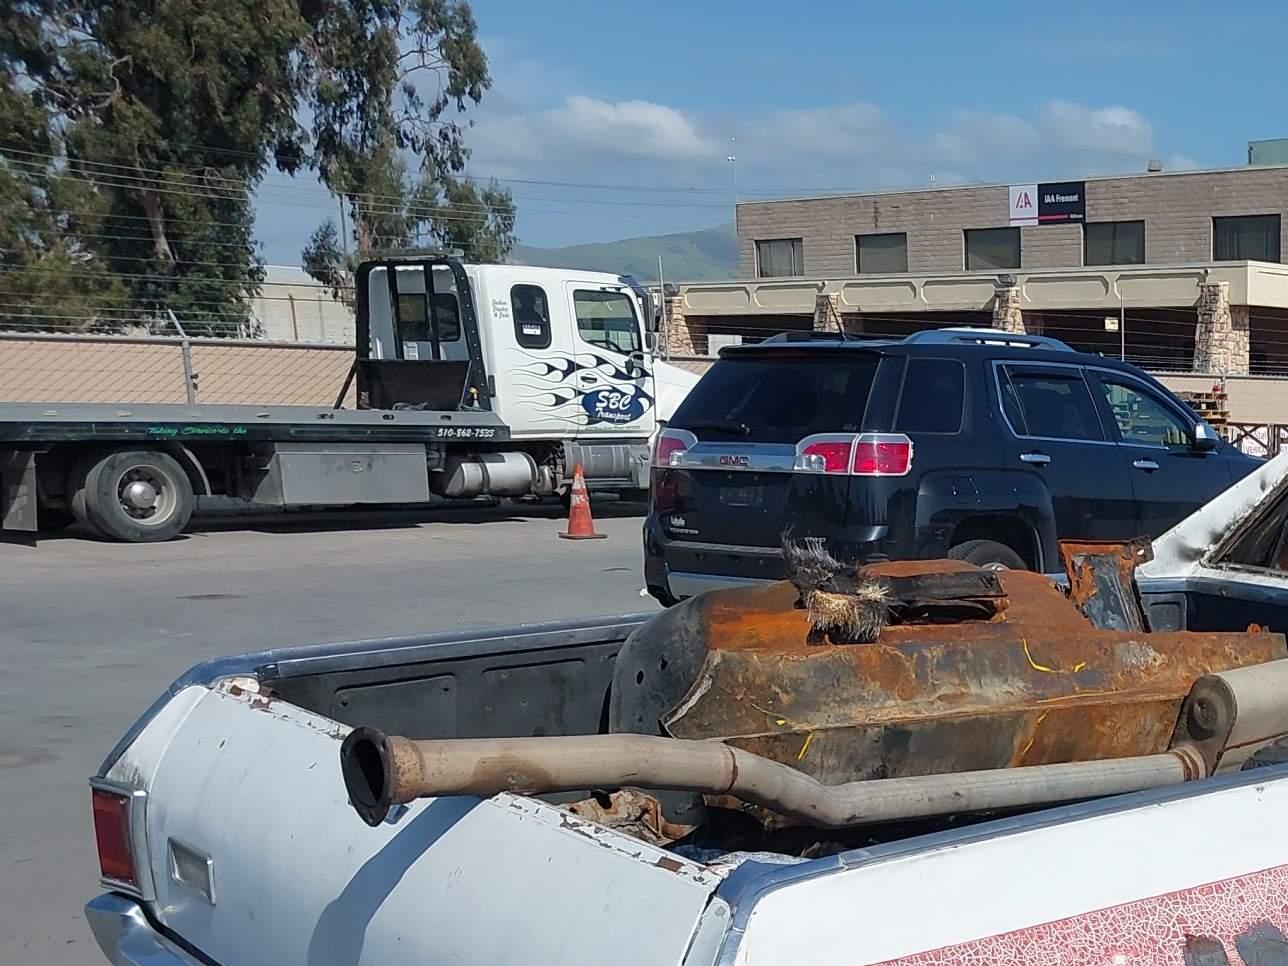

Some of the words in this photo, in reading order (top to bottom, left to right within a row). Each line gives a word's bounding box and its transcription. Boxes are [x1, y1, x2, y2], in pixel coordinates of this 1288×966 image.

[595, 391, 632, 411] SBC
[595, 407, 632, 423] Transport
[719, 455, 750, 466] GMC
